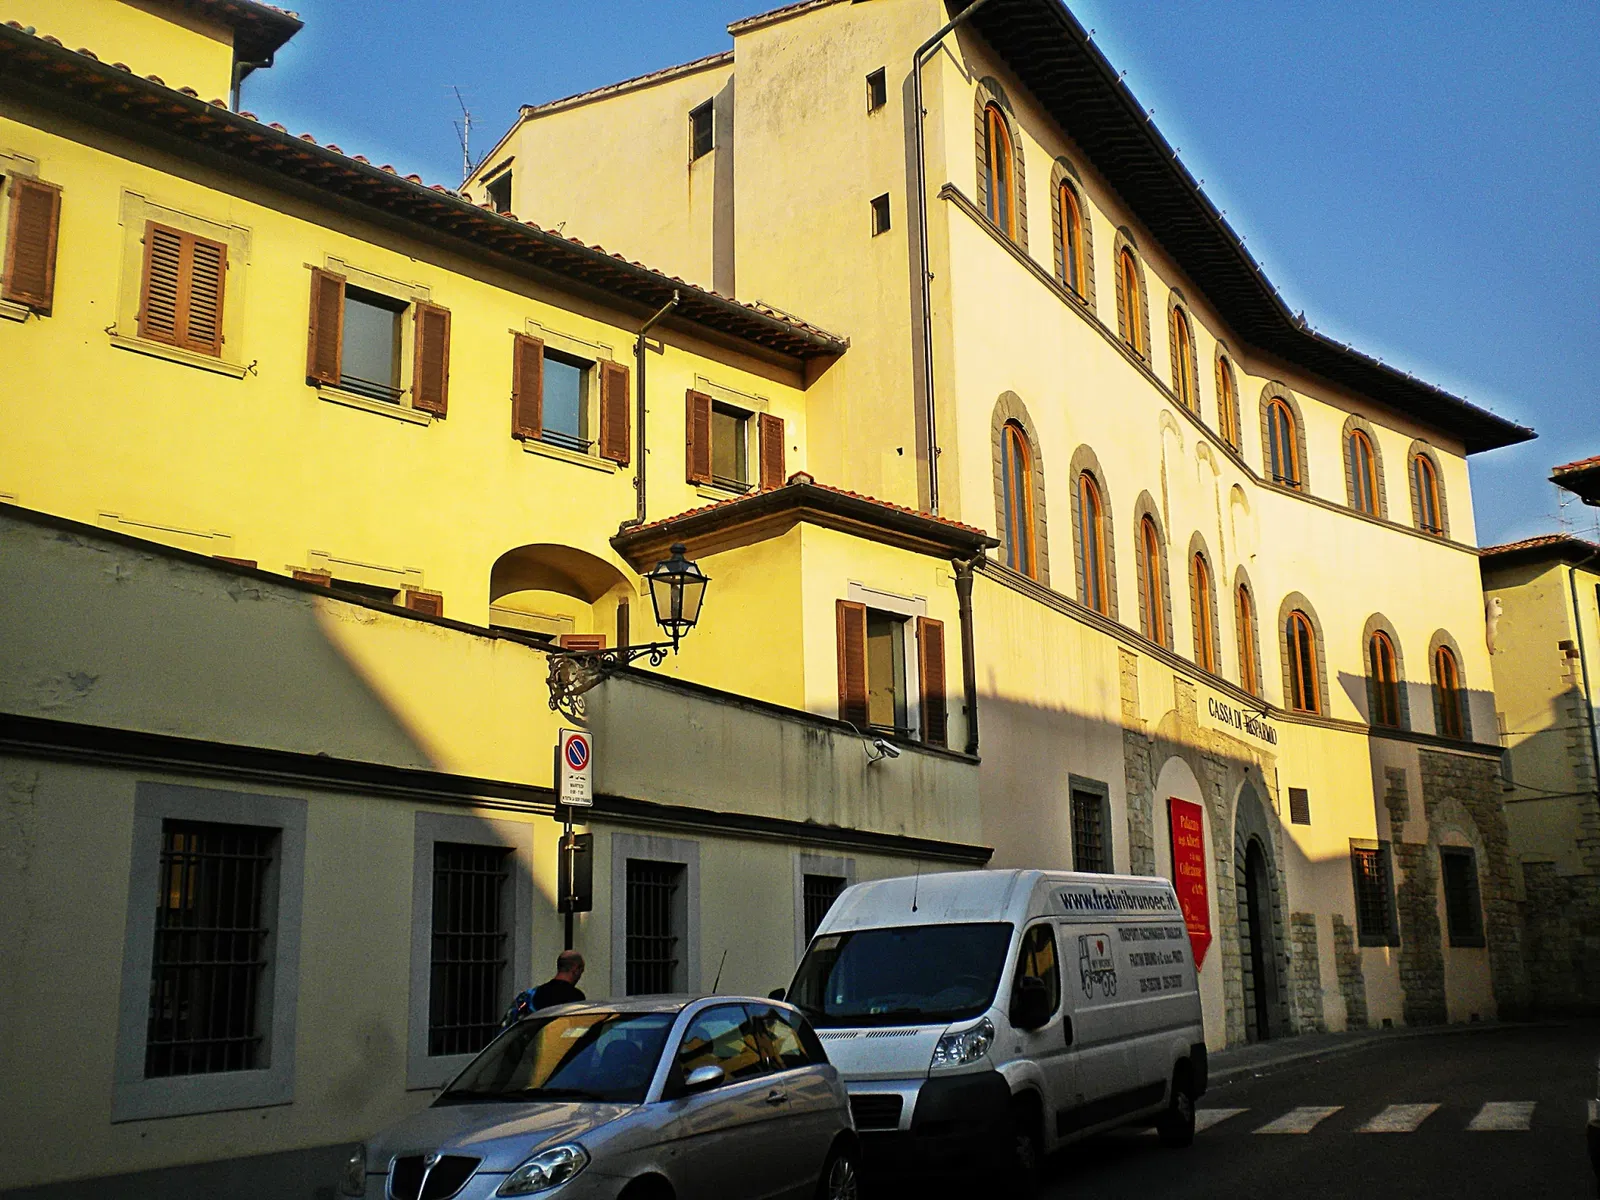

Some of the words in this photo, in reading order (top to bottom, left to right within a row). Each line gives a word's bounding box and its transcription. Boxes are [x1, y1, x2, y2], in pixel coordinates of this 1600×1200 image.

[1208, 697, 1234, 726] CASSA
[1234, 709, 1242, 730] DI
[1060, 889, 1176, 910] www.fratinibrunoec.it
